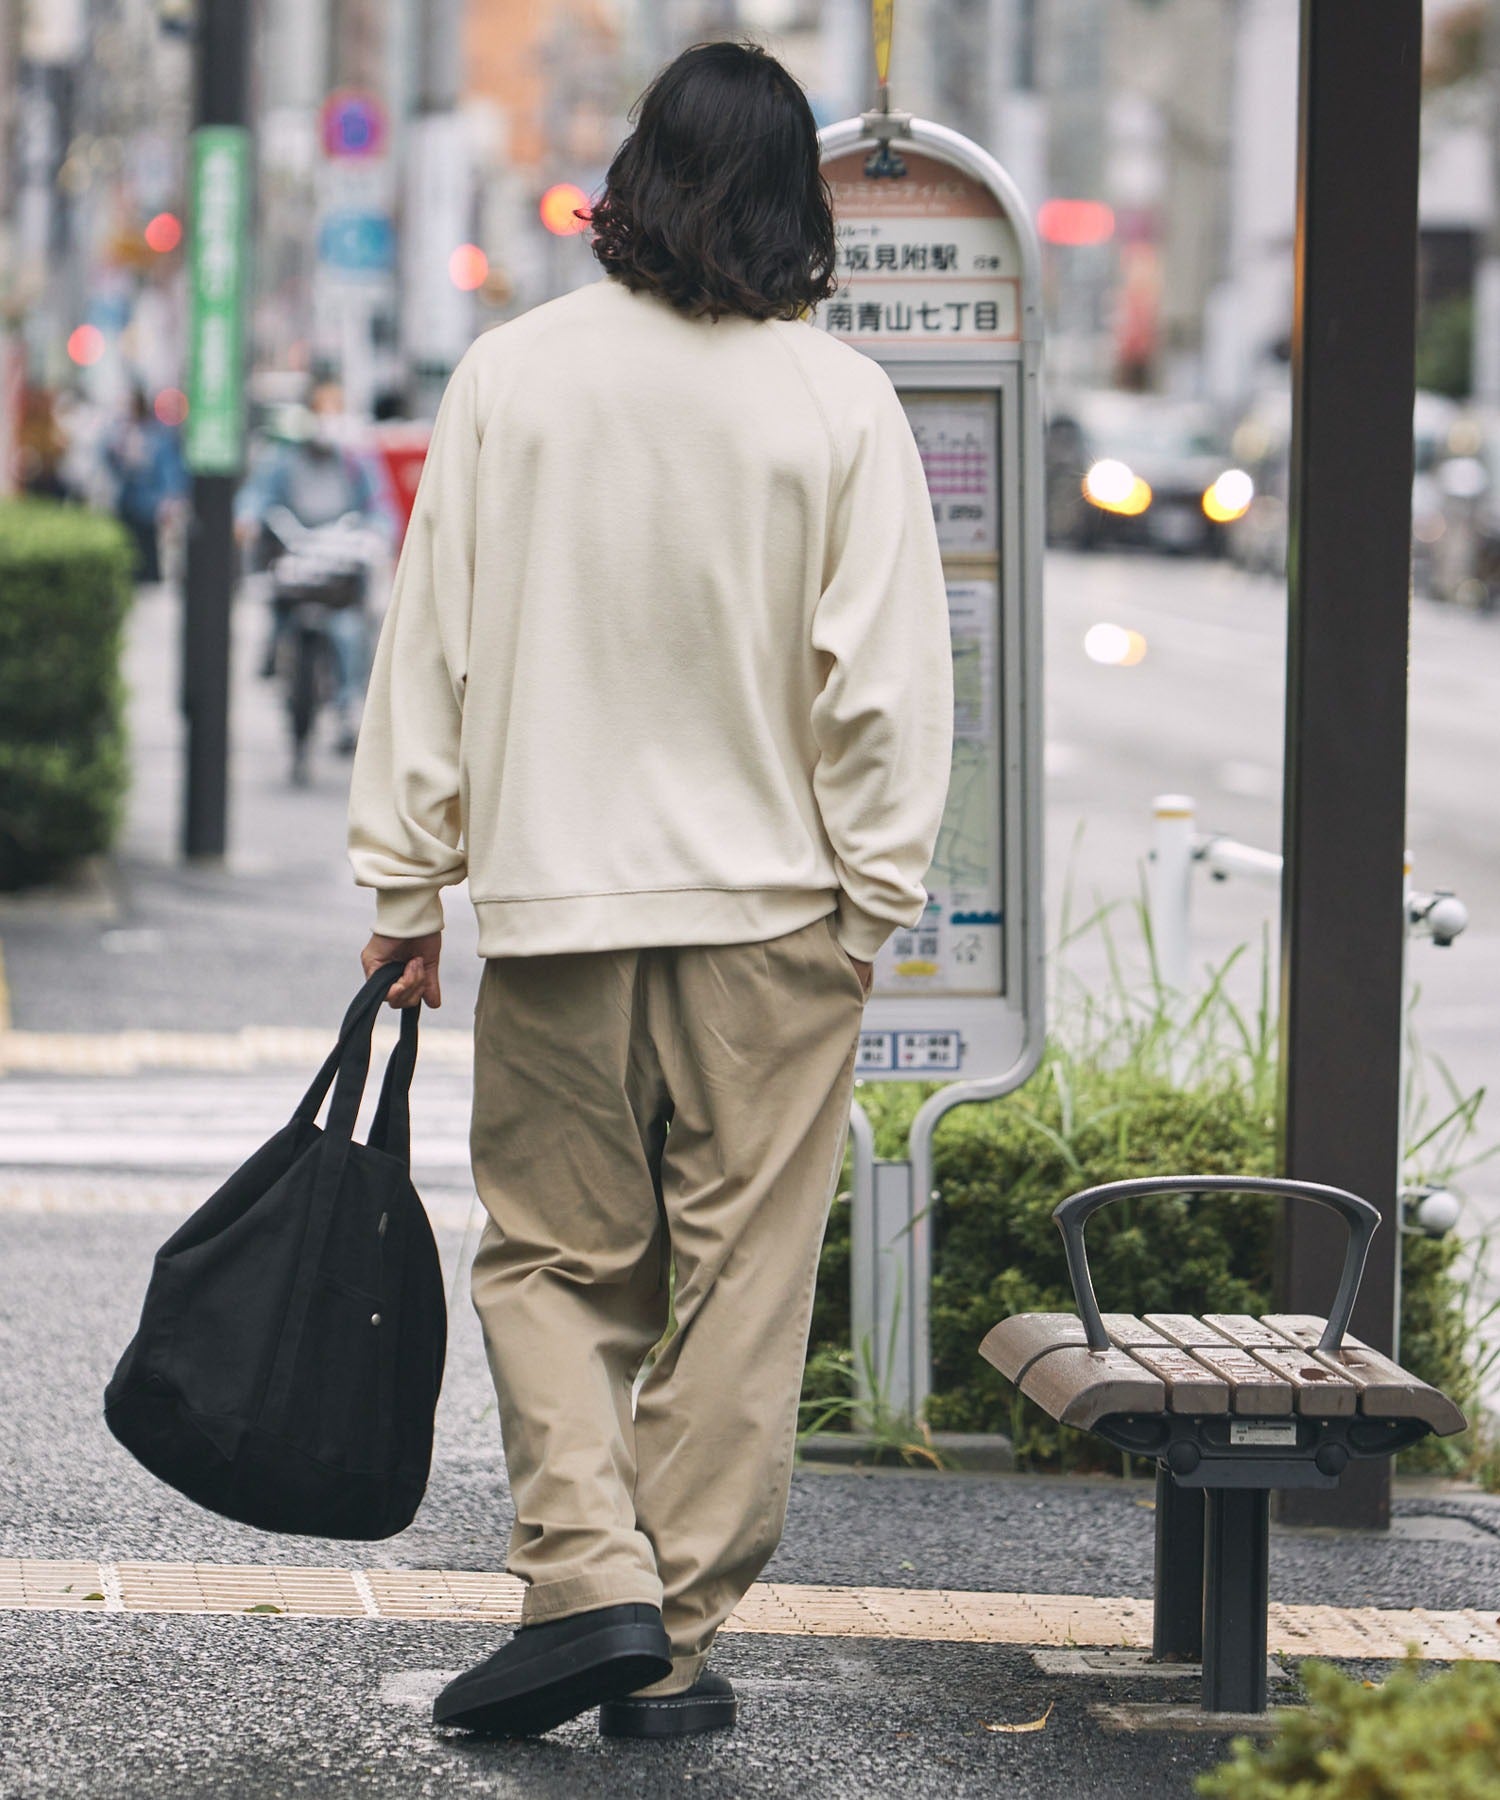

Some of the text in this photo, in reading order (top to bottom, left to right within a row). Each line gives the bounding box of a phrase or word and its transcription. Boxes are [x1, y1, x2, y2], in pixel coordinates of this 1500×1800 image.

[836, 244, 958, 271] 坂見附駅
[827, 301, 998, 332] 南青山七丁目
